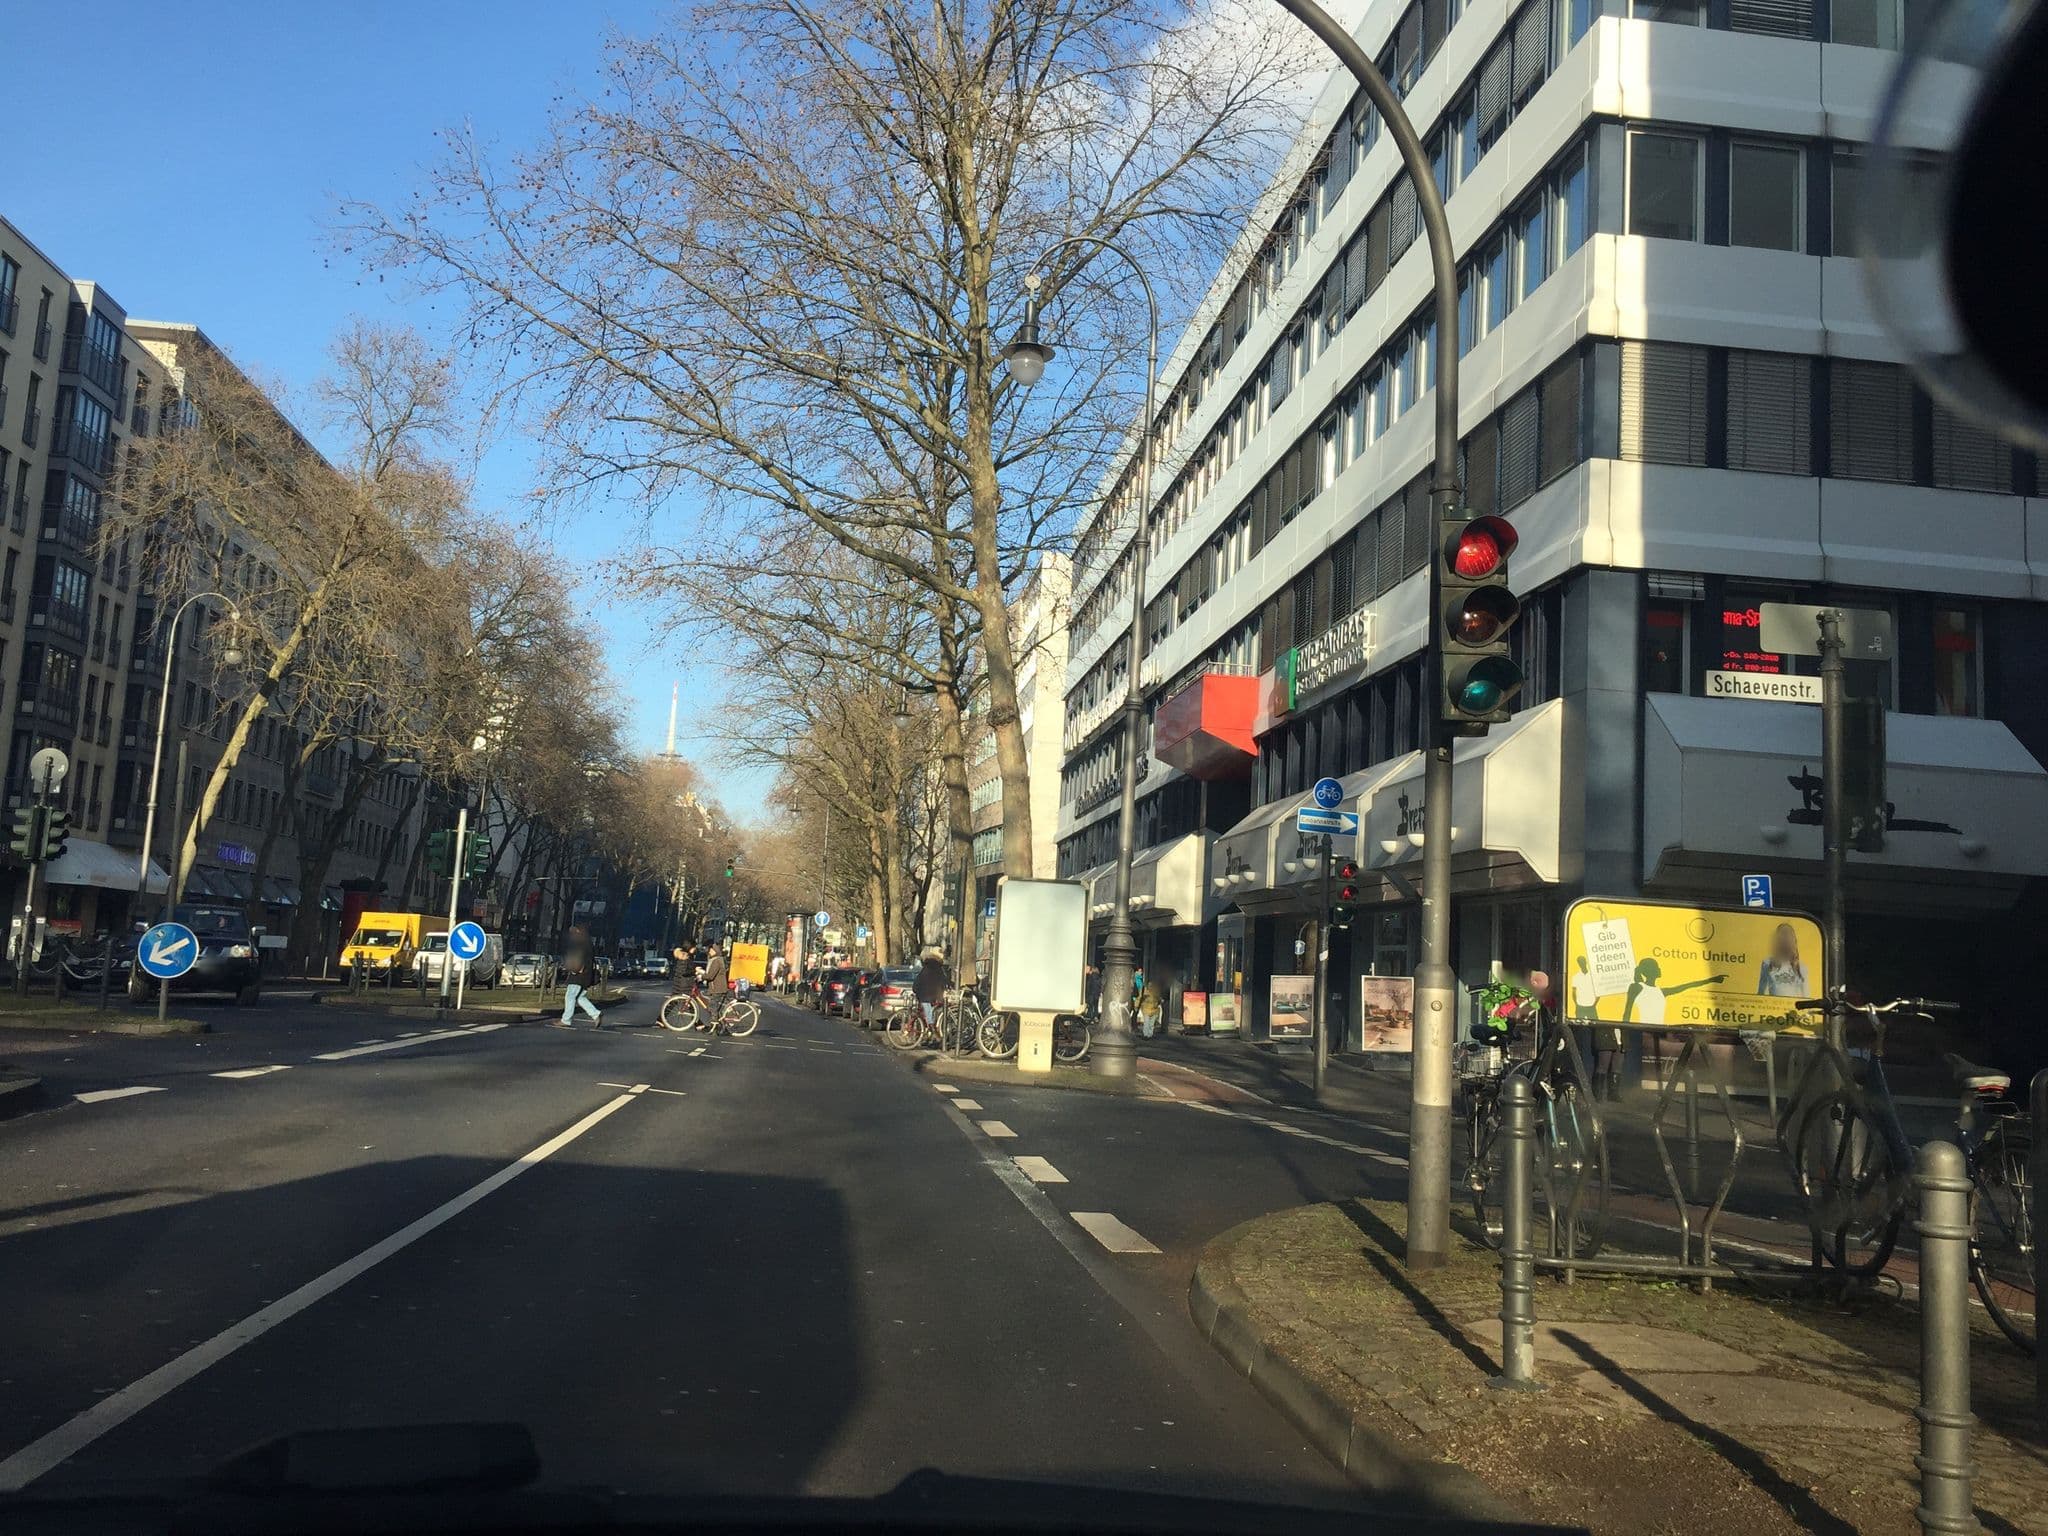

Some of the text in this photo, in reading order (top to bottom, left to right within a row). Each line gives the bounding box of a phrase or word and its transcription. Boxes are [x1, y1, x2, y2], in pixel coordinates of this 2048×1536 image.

[1714, 674, 1816, 698] Schaevenstr.
[1747, 879, 1760, 896] P
[1598, 931, 1616, 942] Gib
[1591, 941, 1627, 953] deinen
[1595, 952, 1626, 963] Ideen
[1652, 946, 1746, 964] Cotton United
[1596, 961, 1630, 974] Raum!
[1681, 1006, 1700, 1020] 50
[1706, 1007, 1754, 1024] Meter
